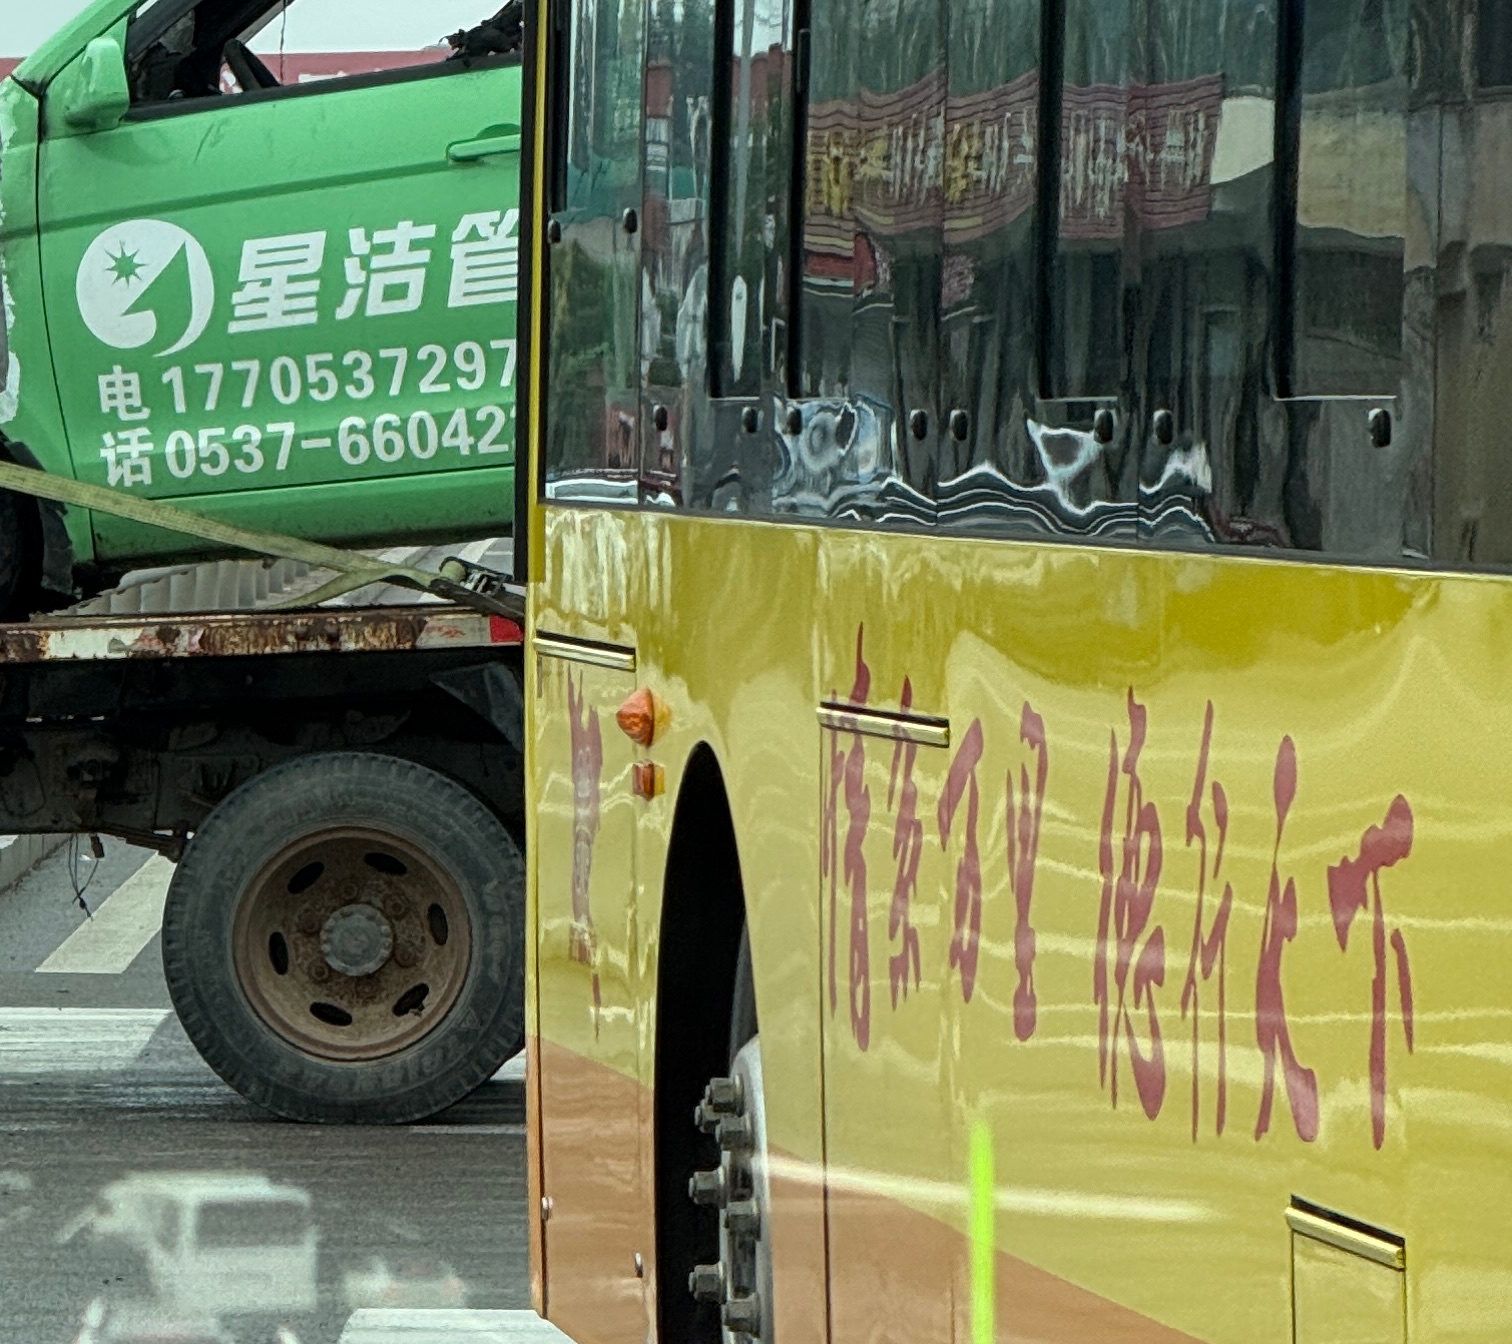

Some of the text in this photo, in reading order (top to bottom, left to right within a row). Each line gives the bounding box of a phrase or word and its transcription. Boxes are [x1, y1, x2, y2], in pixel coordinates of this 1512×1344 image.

[228, 206, 519, 334] 星洁管
[97, 338, 517, 422] 电 1770537297
[99, 404, 517, 488] 话 0537-66042
